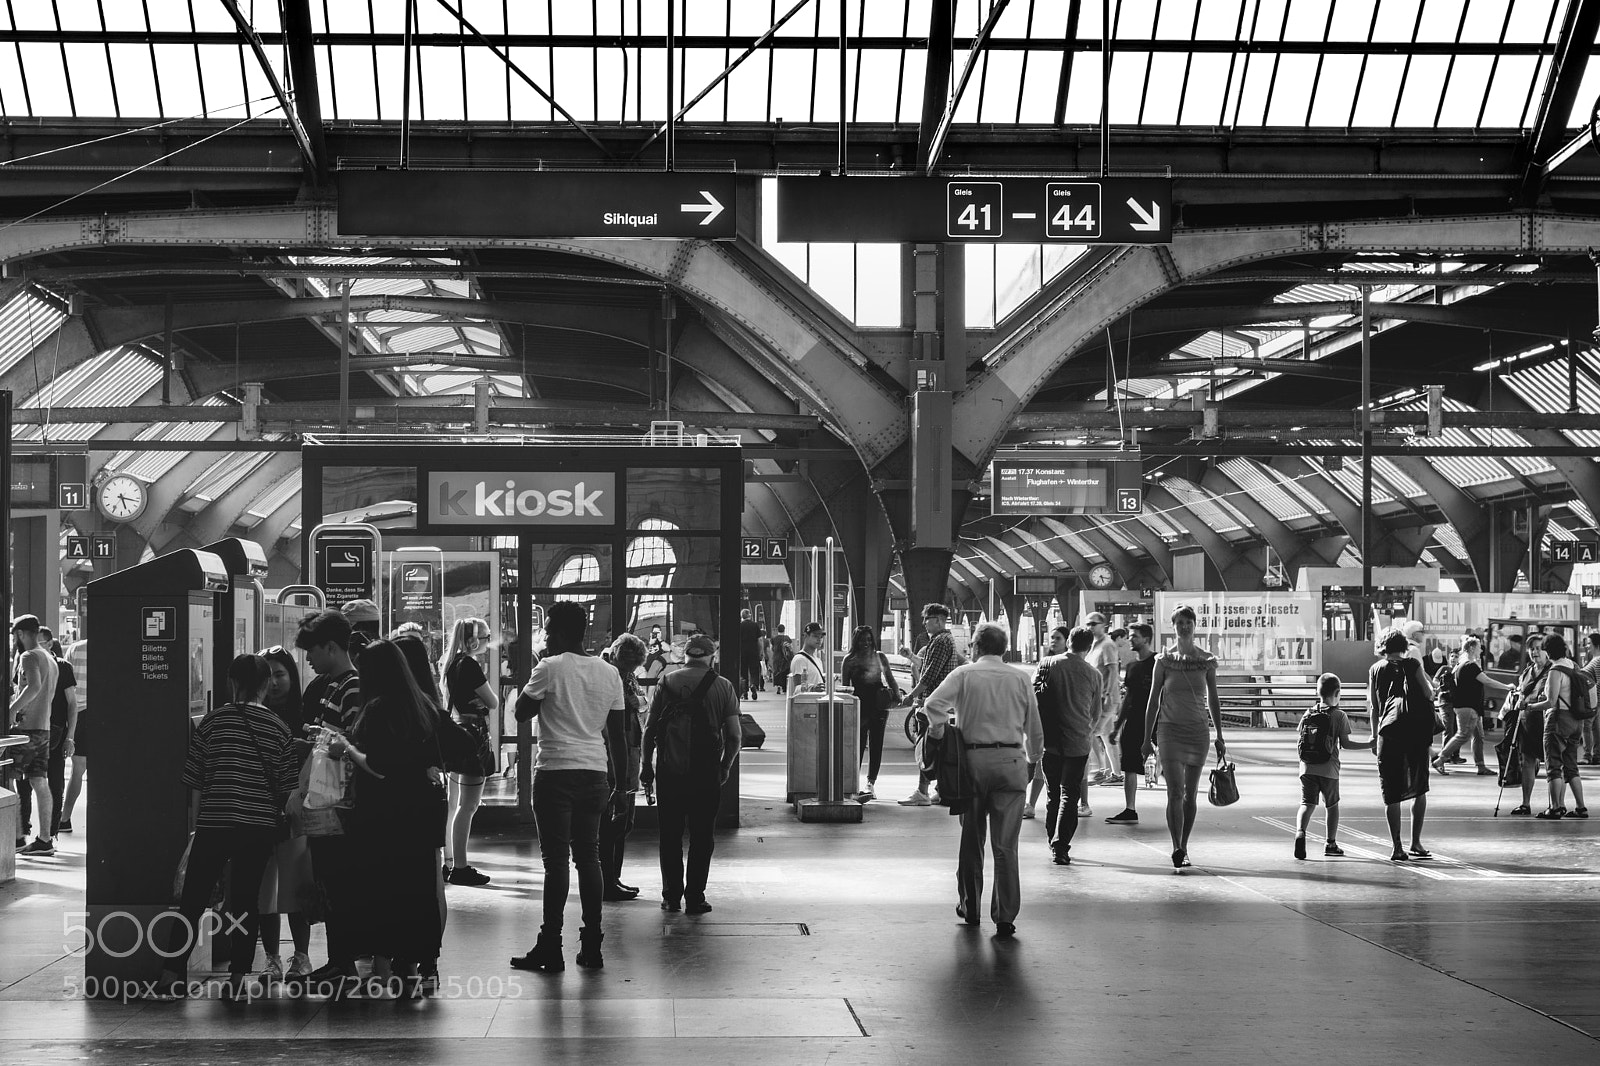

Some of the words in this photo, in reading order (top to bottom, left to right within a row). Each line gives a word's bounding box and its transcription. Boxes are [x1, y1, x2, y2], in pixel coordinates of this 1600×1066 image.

[954, 188, 973, 196] Gleis
[1053, 189, 1071, 197] Gleis
[603, 213, 658, 228] Sihlquai
[957, 203, 991, 231] 41
[1052, 204, 1096, 231] 44
[65, 492, 78, 505] 11
[439, 481, 468, 516] k
[475, 479, 604, 517] kiosk
[1121, 497, 1137, 510] 13
[73, 543, 84, 556] A
[98, 543, 109, 556] 11
[744, 544, 760, 556] 12
[772, 544, 782, 557] A
[1555, 547, 1570, 560] 14
[1581, 548, 1592, 560] A
[1143, 589, 1151, 597] 14
[1425, 602, 1465, 625] NEIN
[1224, 616, 1253, 630] jedes
[142, 644, 167, 652] Billette
[1267, 637, 1315, 660] JETZT
[142, 654, 165, 662] Billets
[142, 663, 169, 672] Biglietti
[142, 672, 169, 680] Tickets
